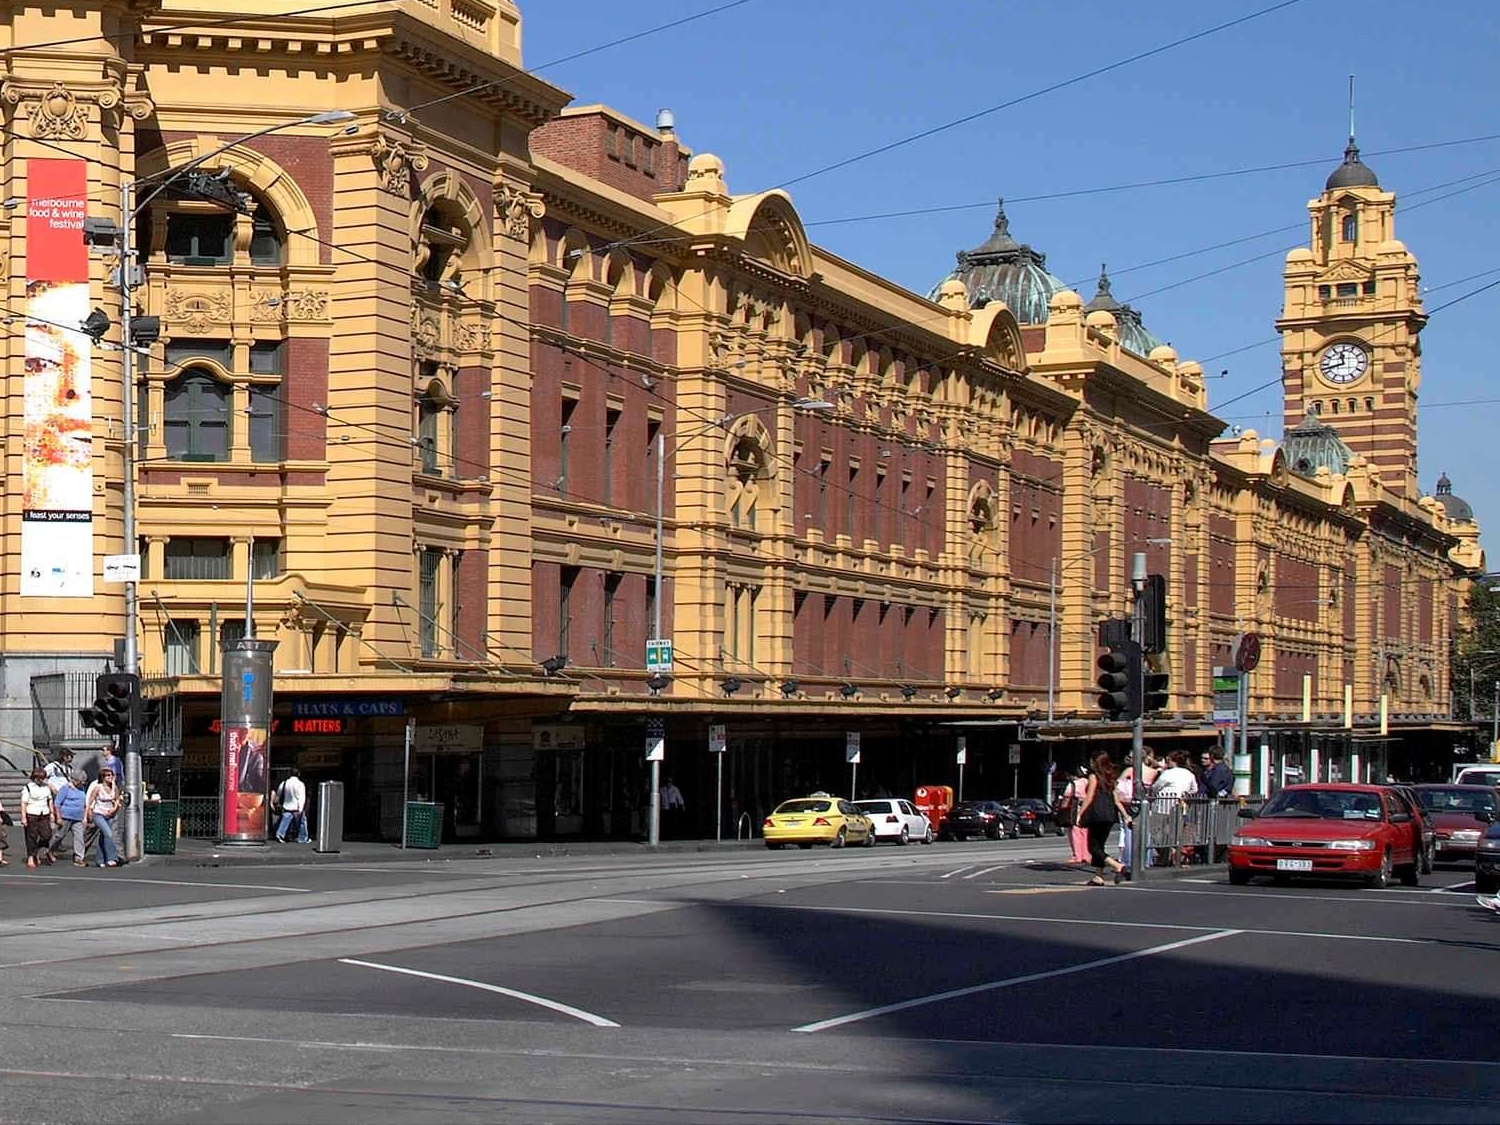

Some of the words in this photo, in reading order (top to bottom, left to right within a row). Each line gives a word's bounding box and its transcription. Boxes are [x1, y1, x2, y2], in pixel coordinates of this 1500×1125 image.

[31, 198, 85, 208] melbourne
[29, 207, 50, 218] food
[51, 208, 60, 218] &
[61, 208, 85, 219] wine
[49, 218, 85, 229] festival
[29, 511, 47, 519] feast
[297, 703, 339, 715] HATS
[342, 703, 354, 715] &
[358, 702, 397, 714] CAPS
